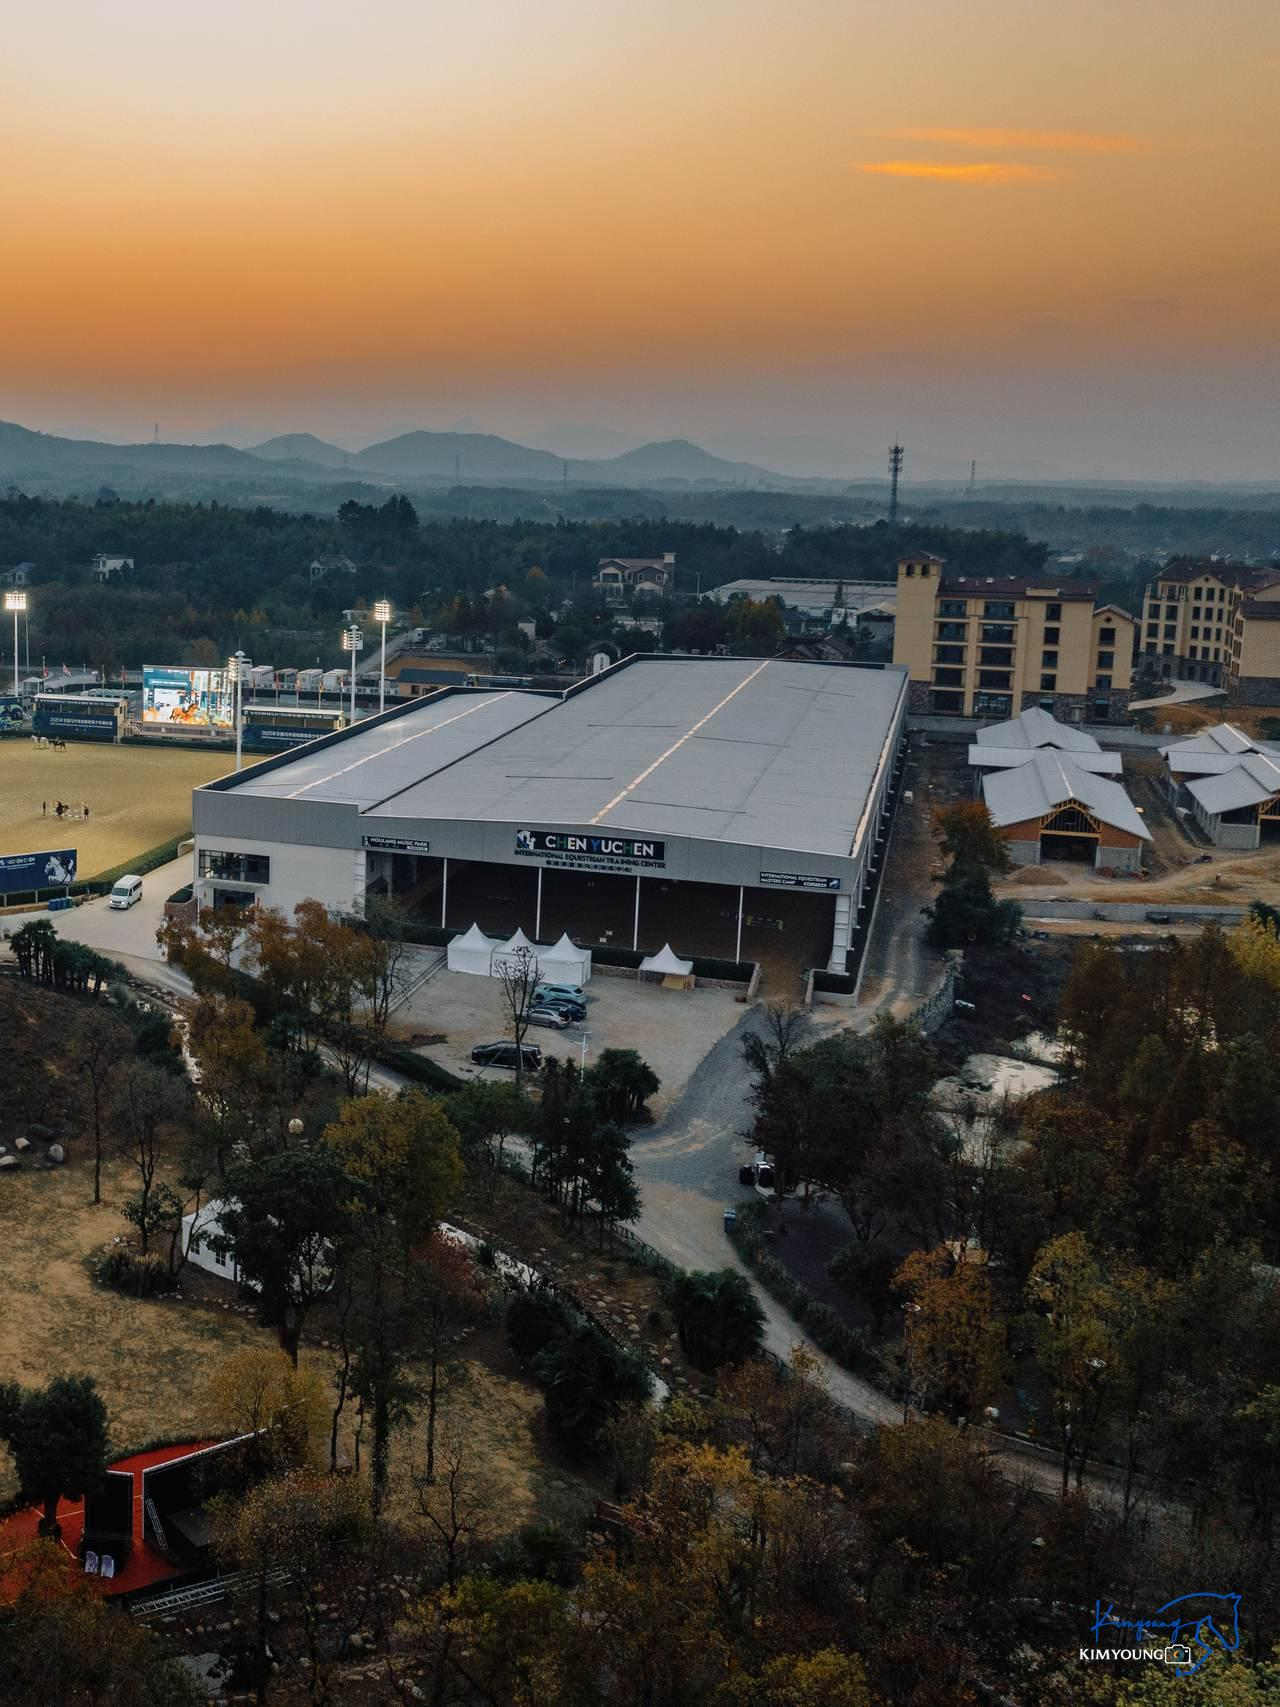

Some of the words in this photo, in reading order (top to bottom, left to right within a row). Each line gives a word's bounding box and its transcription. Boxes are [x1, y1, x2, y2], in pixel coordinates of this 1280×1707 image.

[545, 835, 587, 851] CHEN
[590, 839, 654, 857] YUCHEN
[514, 850, 565, 860] INTERNATIONAL
[565, 854, 606, 864] EQUESTRIAN
[606, 858, 640, 868] TRAINING
[640, 861, 666, 869] CENTER
